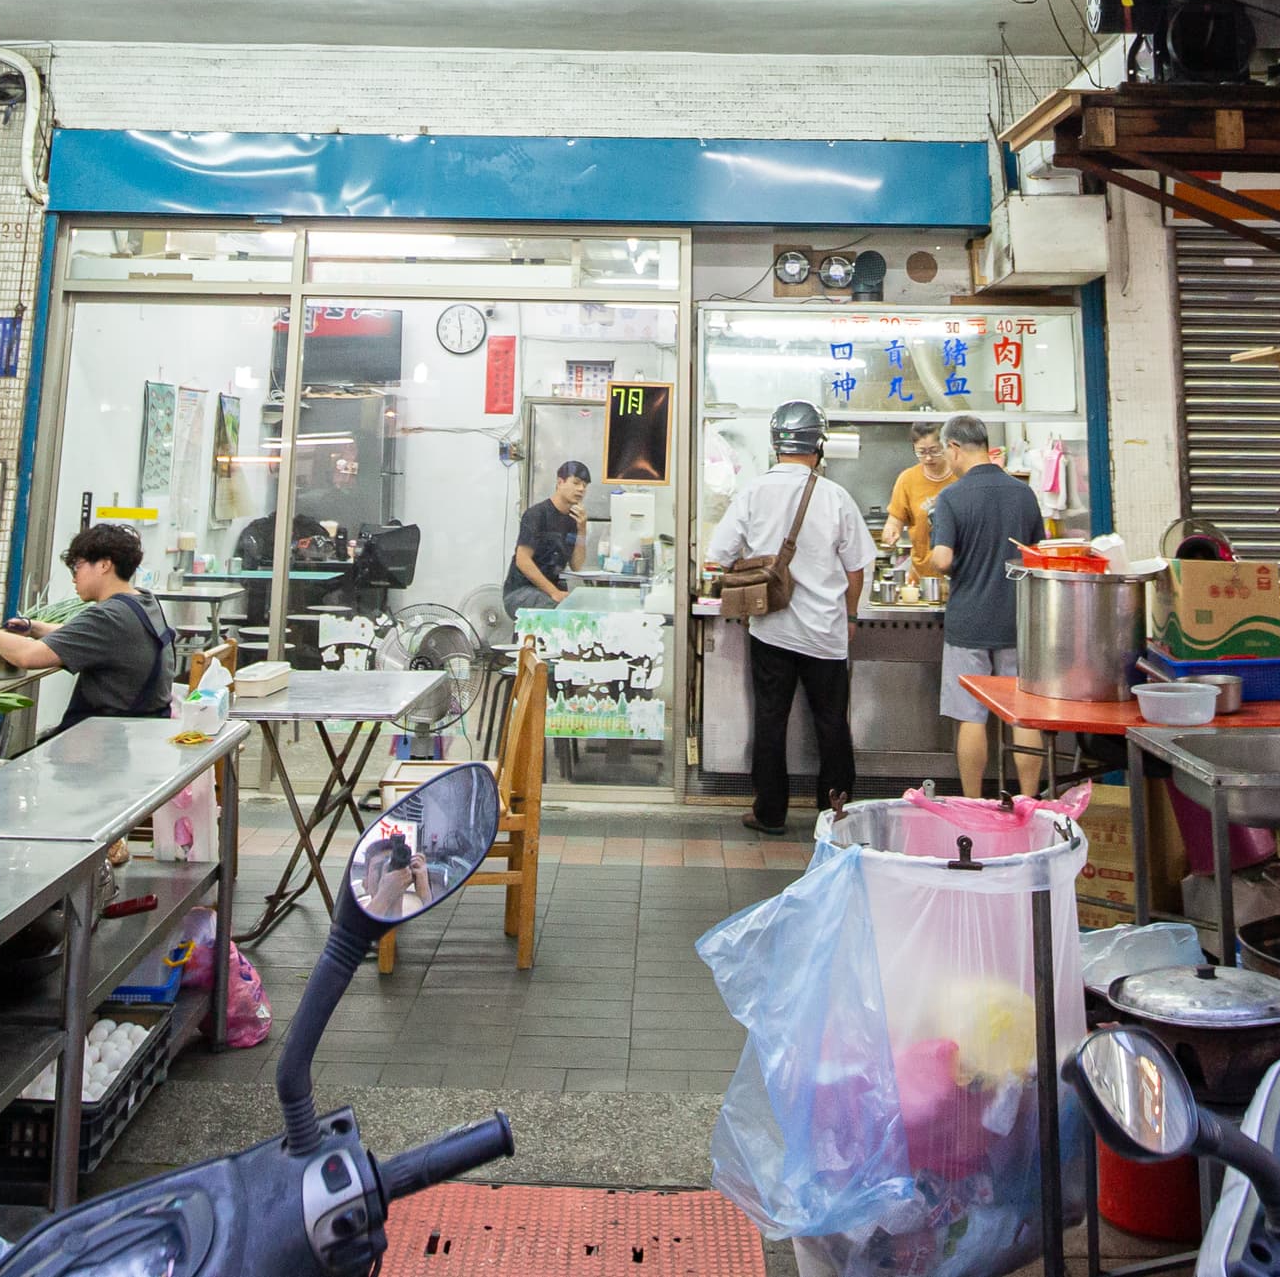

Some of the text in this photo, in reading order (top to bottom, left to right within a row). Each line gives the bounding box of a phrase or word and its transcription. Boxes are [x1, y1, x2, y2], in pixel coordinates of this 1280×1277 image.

[830, 342, 857, 402] 四神
[884, 339, 914, 402] 貢丸
[943, 338, 972, 397] 豬血
[992, 336, 1023, 407] 肉圓
